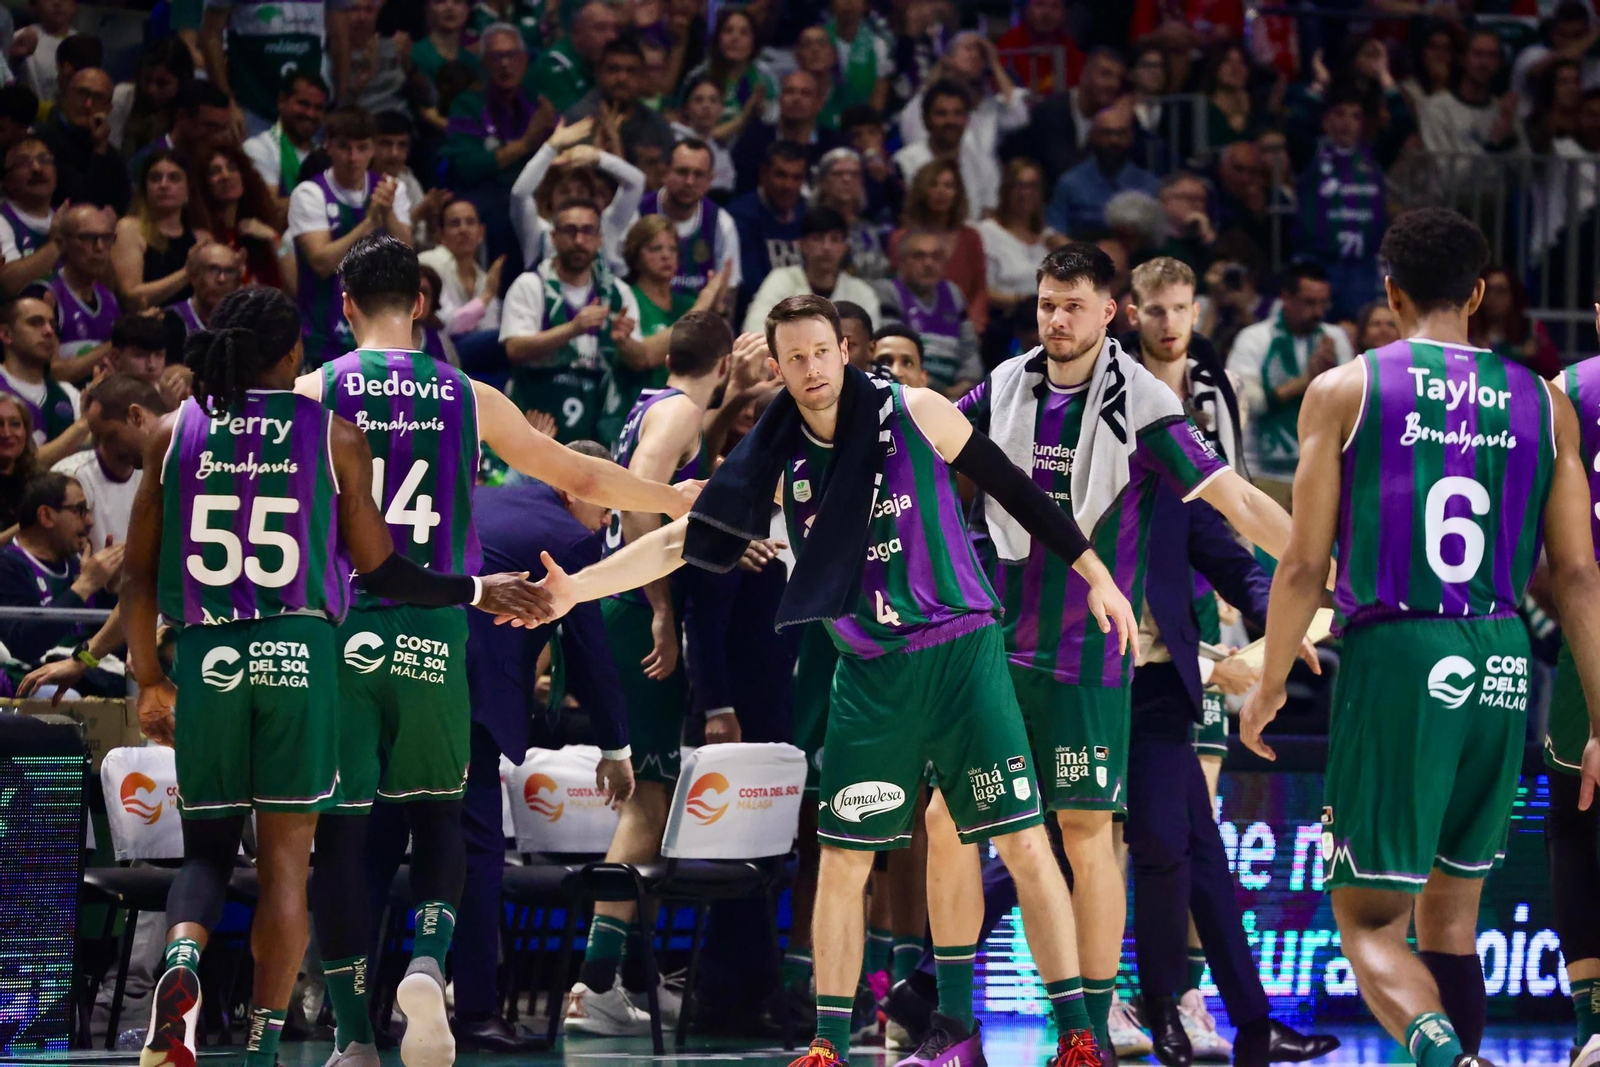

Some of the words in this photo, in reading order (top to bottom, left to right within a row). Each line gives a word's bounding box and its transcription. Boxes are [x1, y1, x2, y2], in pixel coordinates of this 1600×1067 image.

[343, 370, 455, 401] Đedović
[1407, 366, 1512, 411] Taylor
[562, 397, 585, 428] 9
[209, 409, 293, 444] Perry
[371, 457, 441, 544] 14
[873, 493, 912, 518] caja
[186, 494, 300, 588] 55
[1425, 476, 1491, 583] 6
[866, 537, 902, 562] aga
[248, 641, 310, 659] COSTA
[396, 634, 450, 657] COSTA
[248, 659, 278, 673] DEL
[280, 659, 310, 674] SOL
[393, 650, 421, 666] DEL
[423, 656, 448, 671] SOL
[1485, 655, 1528, 676] COST
[249, 672, 309, 688] MÁLAGA
[389, 664, 445, 684] MÁLAGA
[1482, 675, 1516, 692] DEL
[1478, 691, 1528, 711] MÁLAG
[974, 763, 1005, 788] má
[567, 787, 594, 797] COSTA
[739, 787, 768, 798] COSTA
[769, 786, 783, 797] DEL
[784, 785, 799, 796] SOL
[836, 785, 902, 812] famadesa
[972, 783, 1007, 803] laga
[422, 907, 440, 936] UNICAJA
[246, 1015, 267, 1051] UNICAJA
